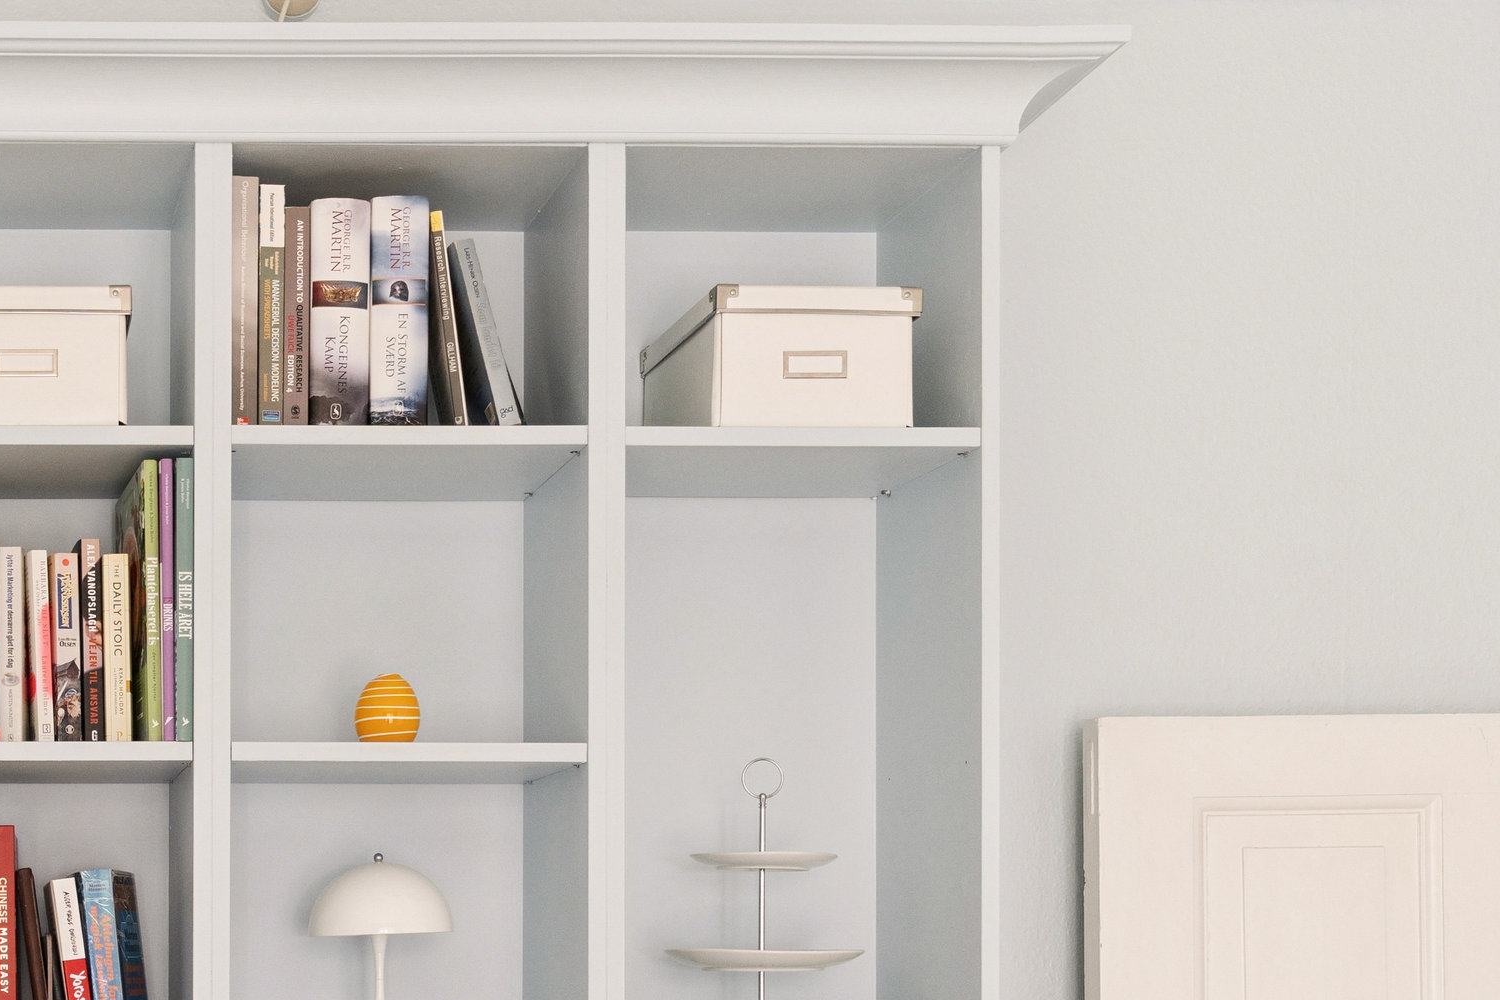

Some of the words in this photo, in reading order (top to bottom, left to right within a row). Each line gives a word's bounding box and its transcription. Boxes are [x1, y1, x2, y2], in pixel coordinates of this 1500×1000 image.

[296, 219, 304, 231] AN
[331, 210, 342, 272] MARTIN
[390, 207, 402, 269] MARTIN
[296, 232, 304, 290] INTRODUCTION
[434, 235, 445, 272] Research
[271, 279, 280, 321] MANAGERIAL
[296, 291, 304, 303] TO
[437, 274, 450, 320] Interviewing
[295, 304, 303, 352] QUALITATIVE
[398, 313, 408, 329] EN
[271, 322, 280, 361] DECISION
[324, 336, 336, 373] KAMP
[337, 315, 350, 393] KONGERNES
[385, 336, 396, 378] SVÆRD
[397, 334, 408, 375] STORM
[446, 341, 457, 373] GILLHAM
[271, 362, 280, 402] MODELING
[295, 355, 303, 393] RESEARCH
[396, 379, 407, 393] AF
[86, 543, 97, 567] ALEX
[179, 570, 192, 580] IS
[86, 570, 97, 632] VANOPSLAGH
[112, 582, 122, 616] DAILY
[145, 556, 159, 634] Plantebaseret
[179, 581, 192, 610] HELE
[112, 620, 123, 657] STOIC
[147, 635, 158, 646] is
[179, 612, 194, 640] ÅRET
[89, 638, 98, 668] VEJEN
[89, 671, 98, 685] TIL
[89, 687, 98, 725] ANSVAR
